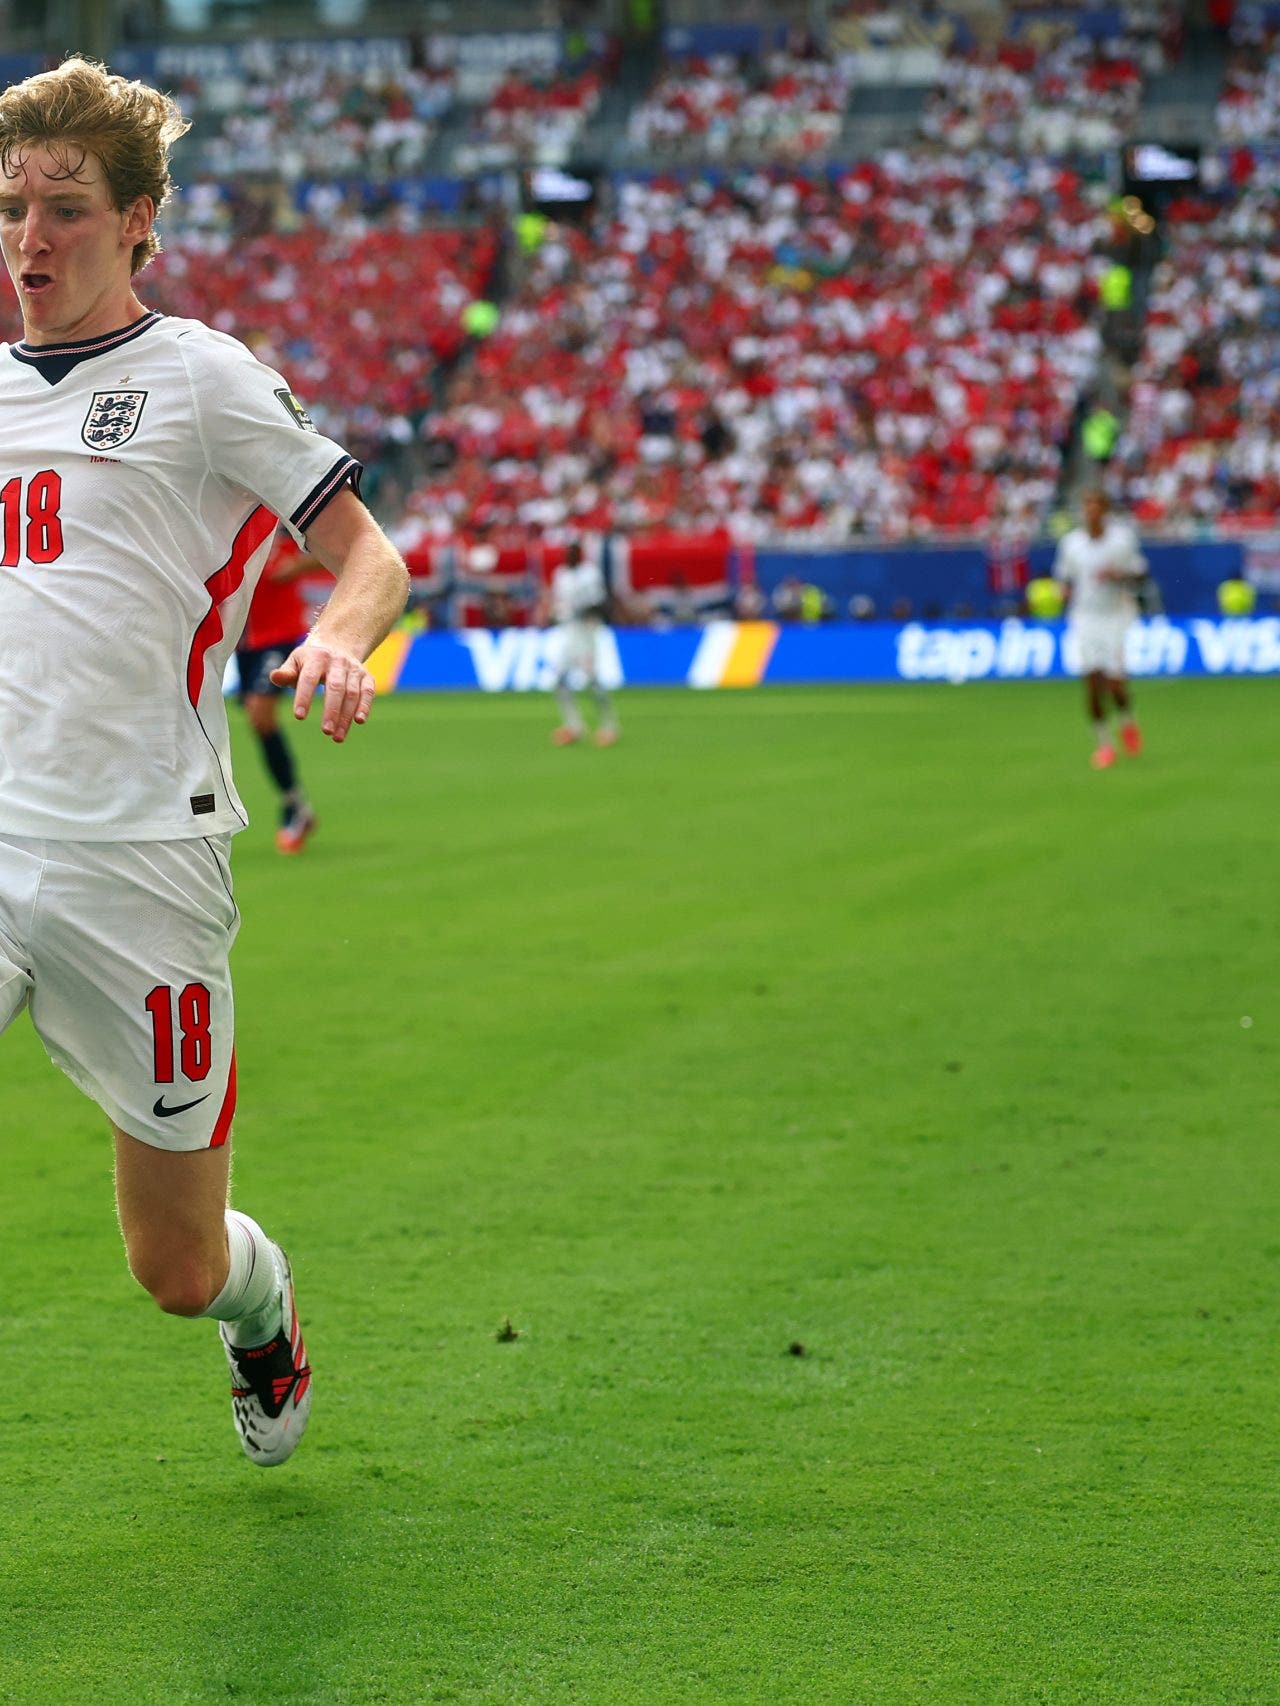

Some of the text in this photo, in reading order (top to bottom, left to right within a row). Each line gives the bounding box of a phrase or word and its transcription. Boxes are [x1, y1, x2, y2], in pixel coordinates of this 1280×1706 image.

[0, 469, 64, 567] 18
[894, 614, 1280, 685] tap in th VIS
[145, 983, 212, 1083] 18
